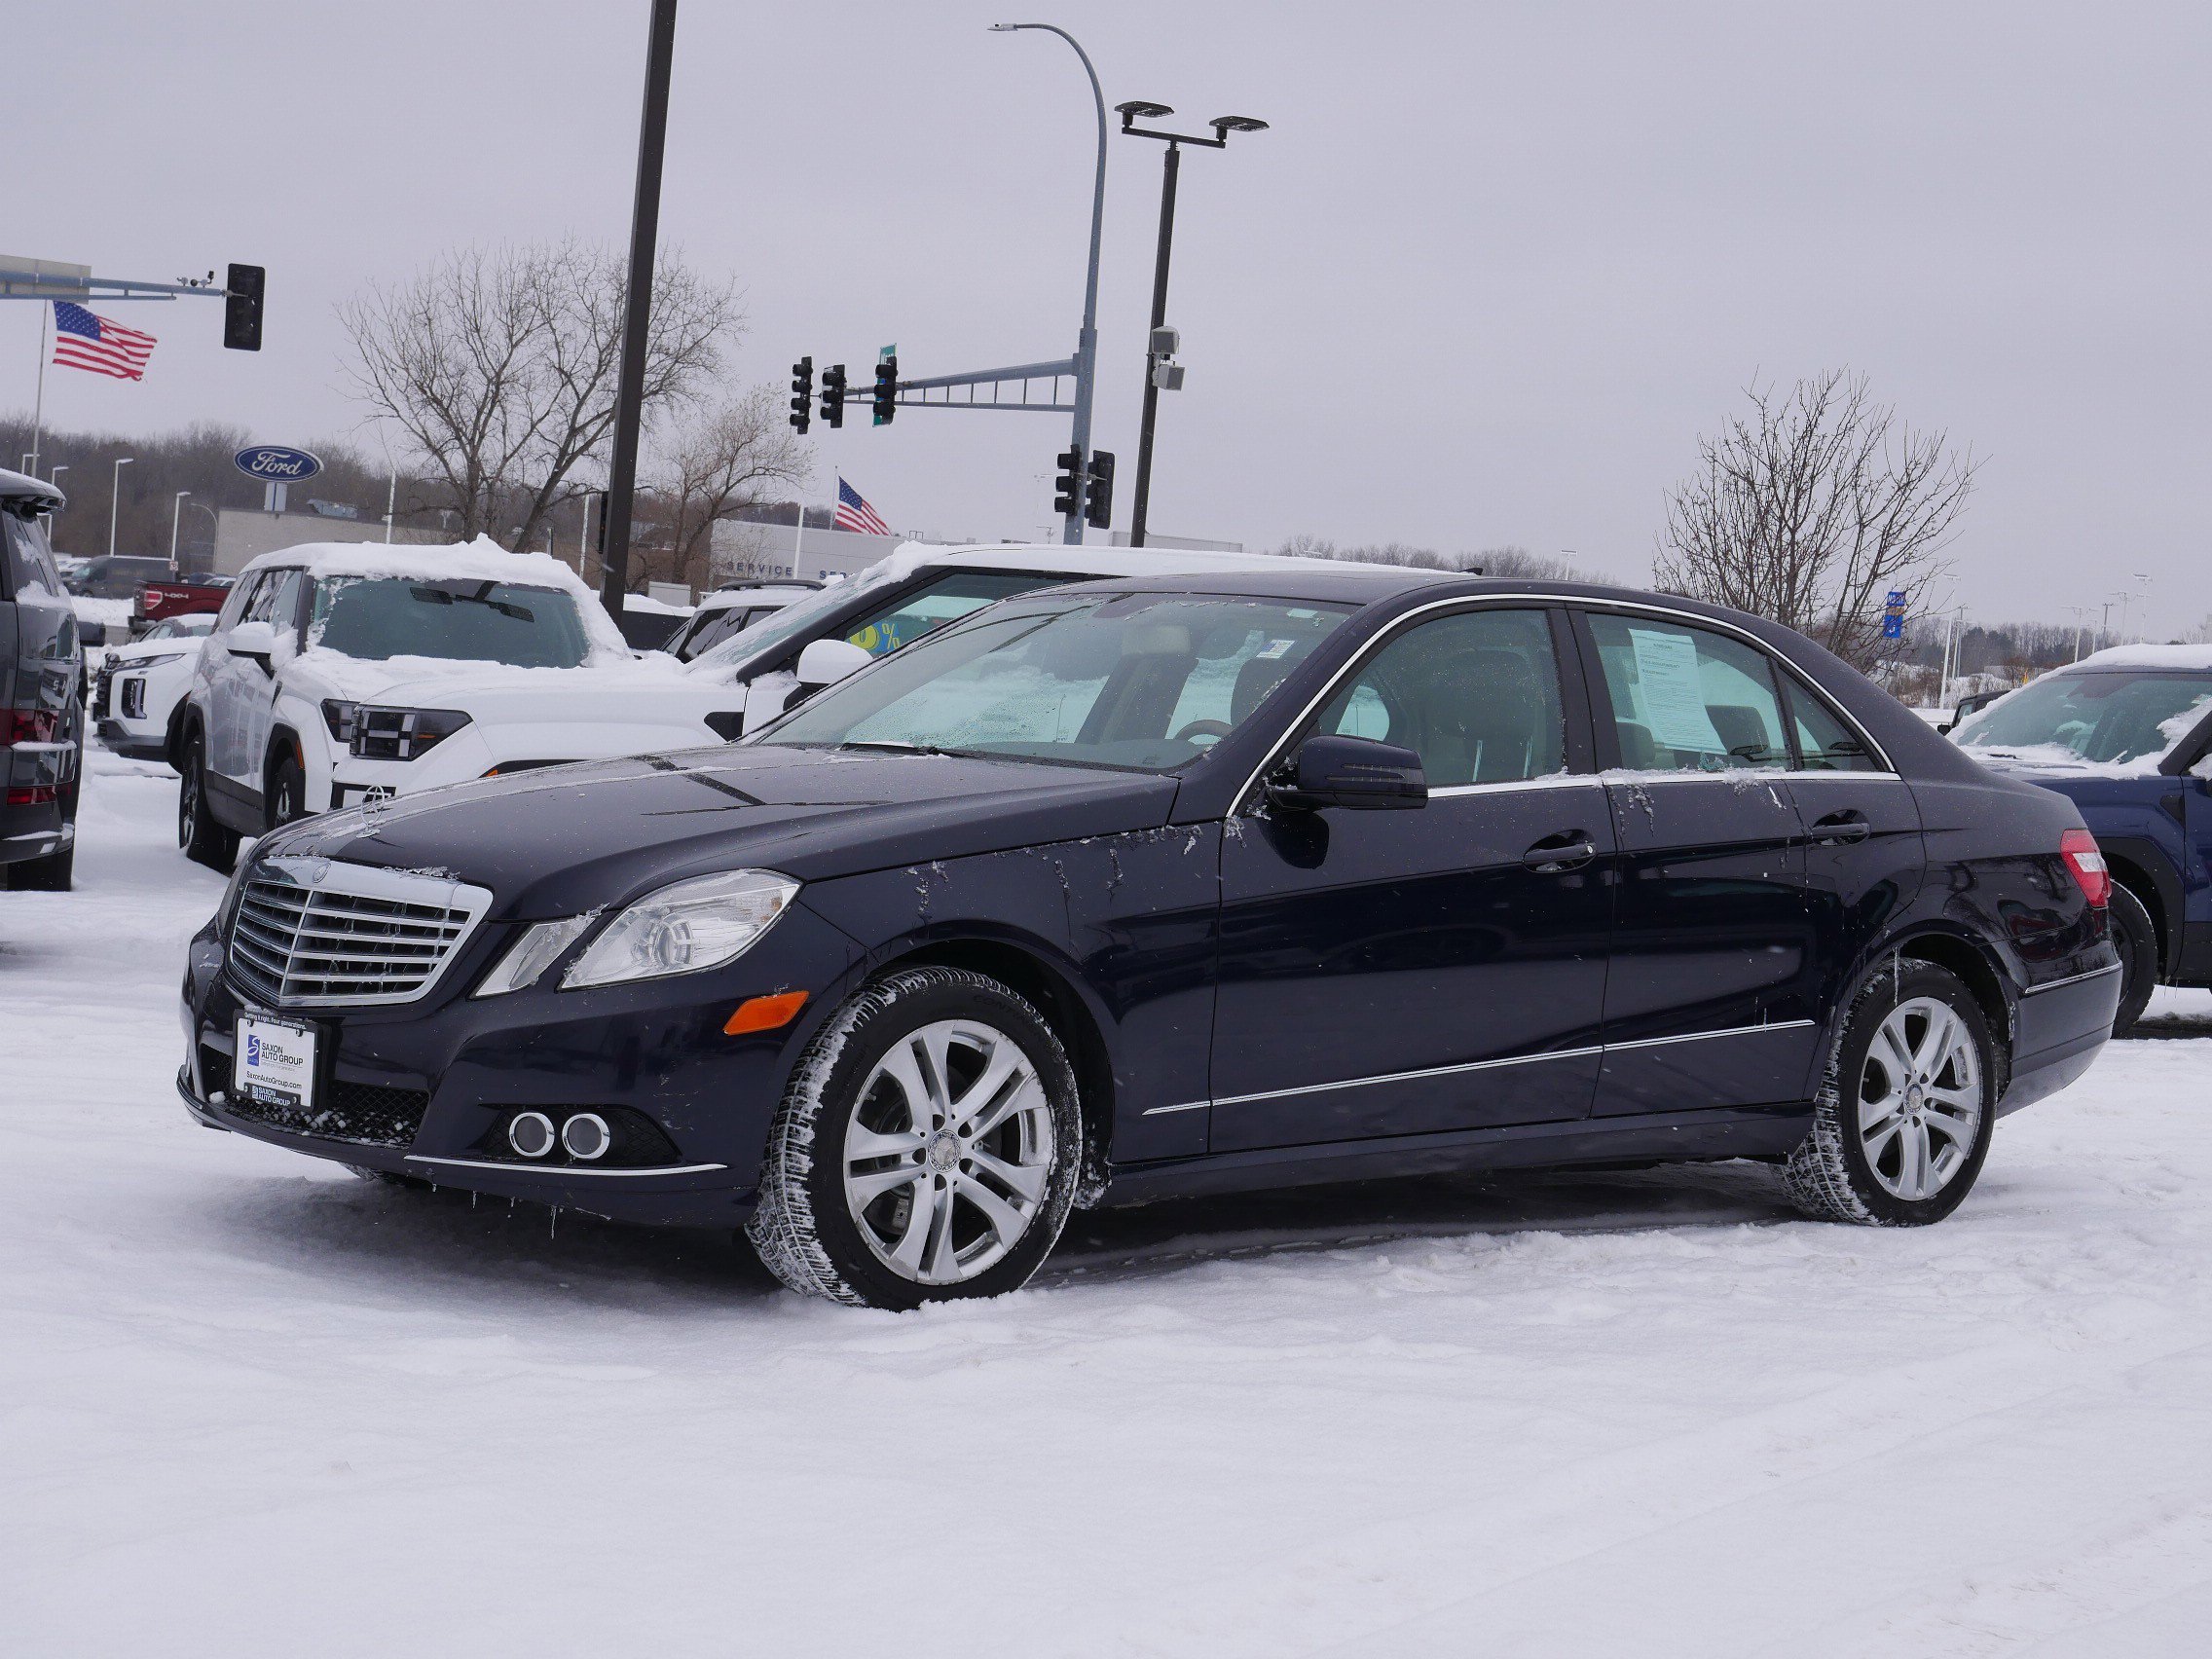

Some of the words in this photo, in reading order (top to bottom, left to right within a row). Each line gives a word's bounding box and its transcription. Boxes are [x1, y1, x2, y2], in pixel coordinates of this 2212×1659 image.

[252, 451, 303, 475] Ford
[726, 562, 793, 576] SERVICE
[262, 1042, 283, 1053] SAXON
[262, 1051, 277, 1061] AUTO
[278, 1053, 304, 1066] GROUP
[246, 1070, 302, 1089] SaxonAutoGroup.com
[273, 1096, 291, 1107] GROUP
